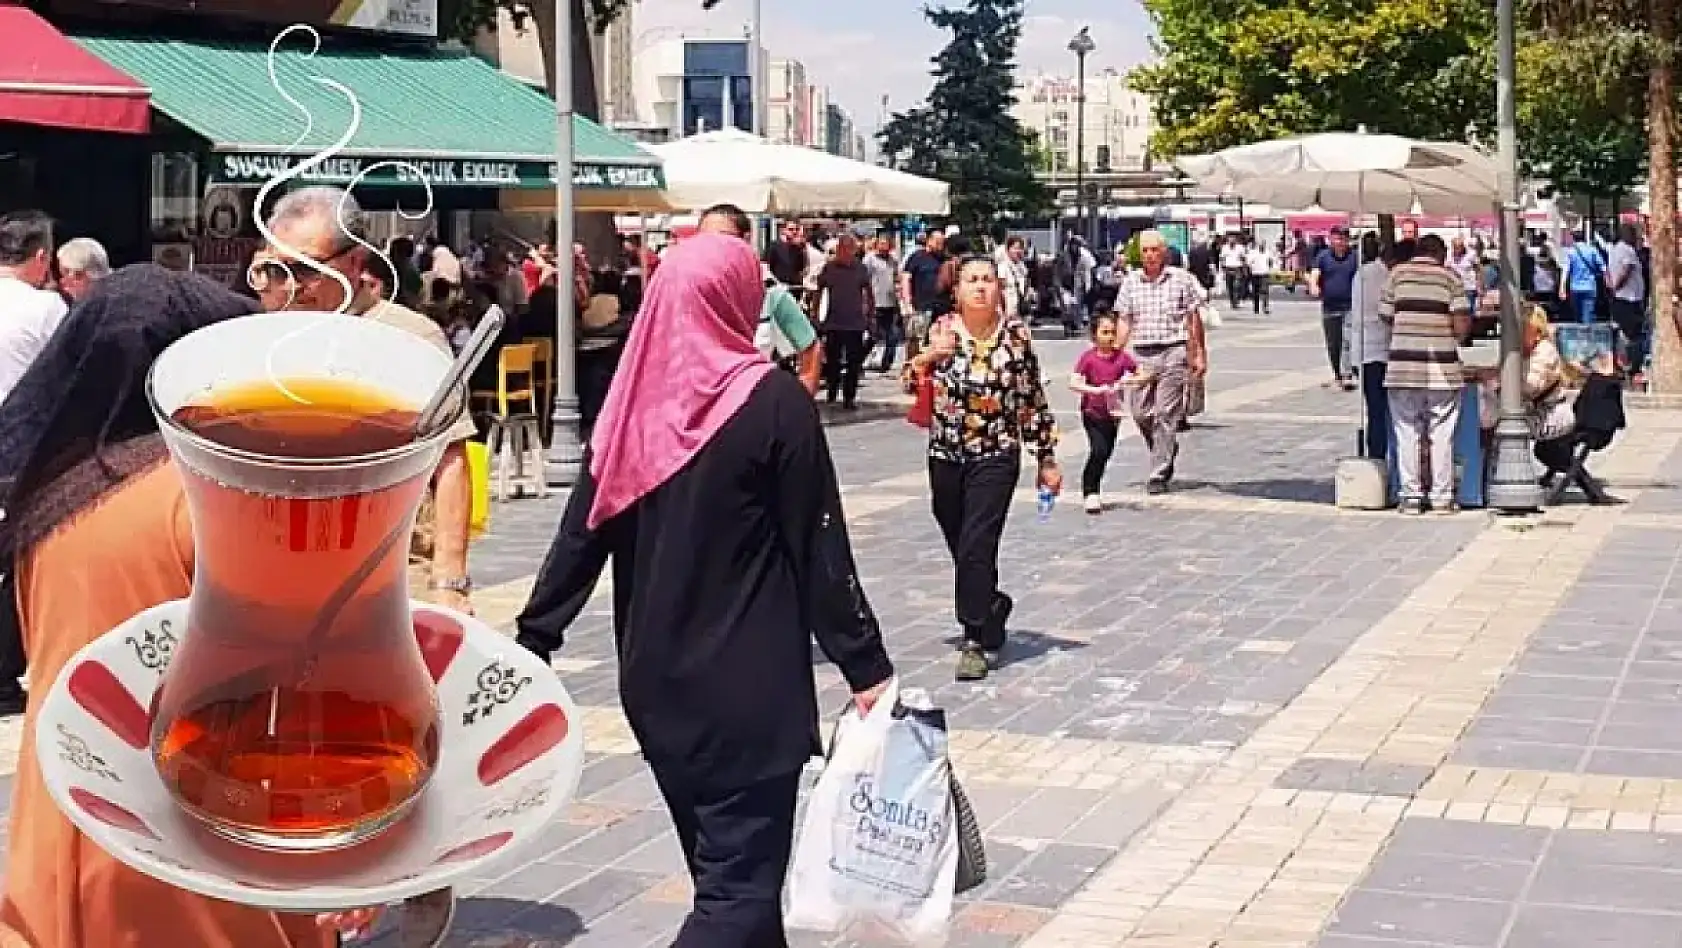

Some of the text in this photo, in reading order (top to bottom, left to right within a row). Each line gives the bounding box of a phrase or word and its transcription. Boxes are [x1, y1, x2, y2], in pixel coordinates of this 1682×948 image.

[396, 160, 521, 184] SUCUK EKMEK
[548, 164, 604, 184] SCUK
